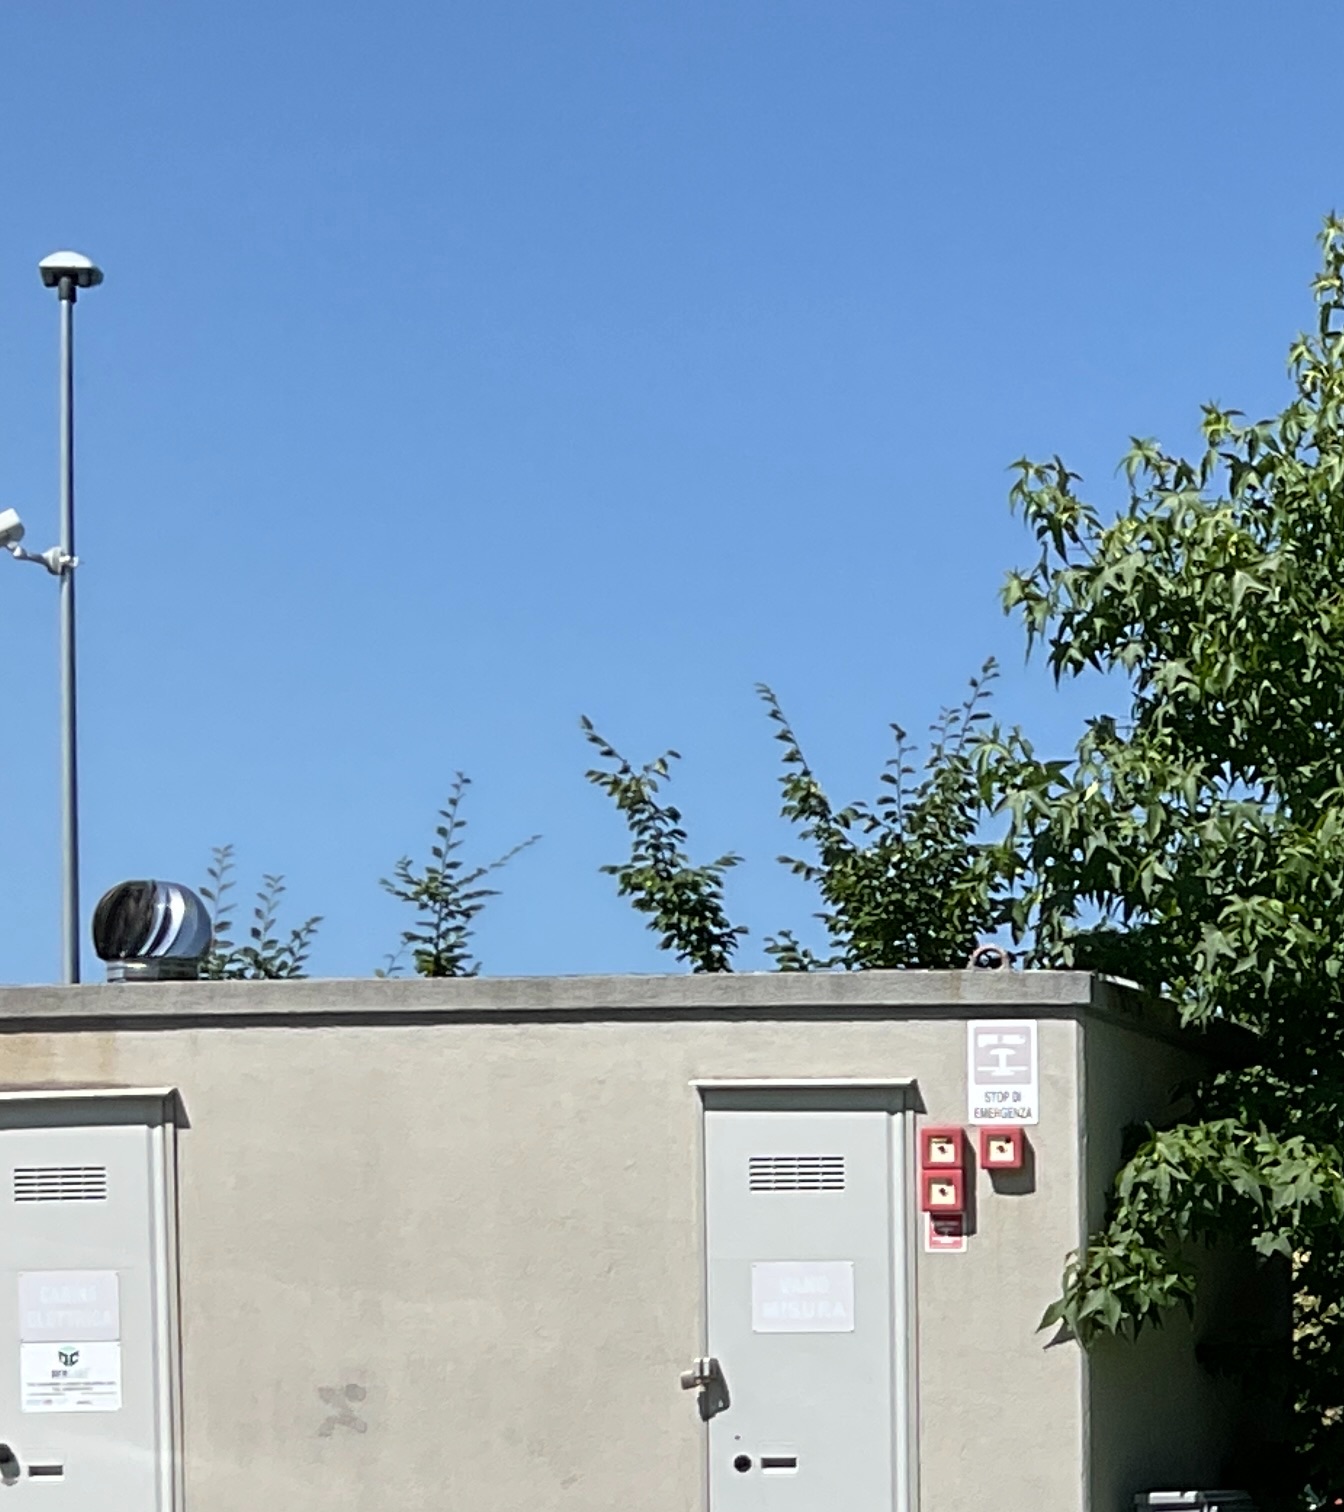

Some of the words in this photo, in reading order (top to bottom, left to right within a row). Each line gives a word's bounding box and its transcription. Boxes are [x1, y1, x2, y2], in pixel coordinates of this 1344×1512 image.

[984, 1091, 1009, 1102] STOP
[1012, 1091, 1021, 1102] DI
[974, 1107, 1032, 1118] EMERGENZA
[762, 1301, 846, 1319] MISURA
